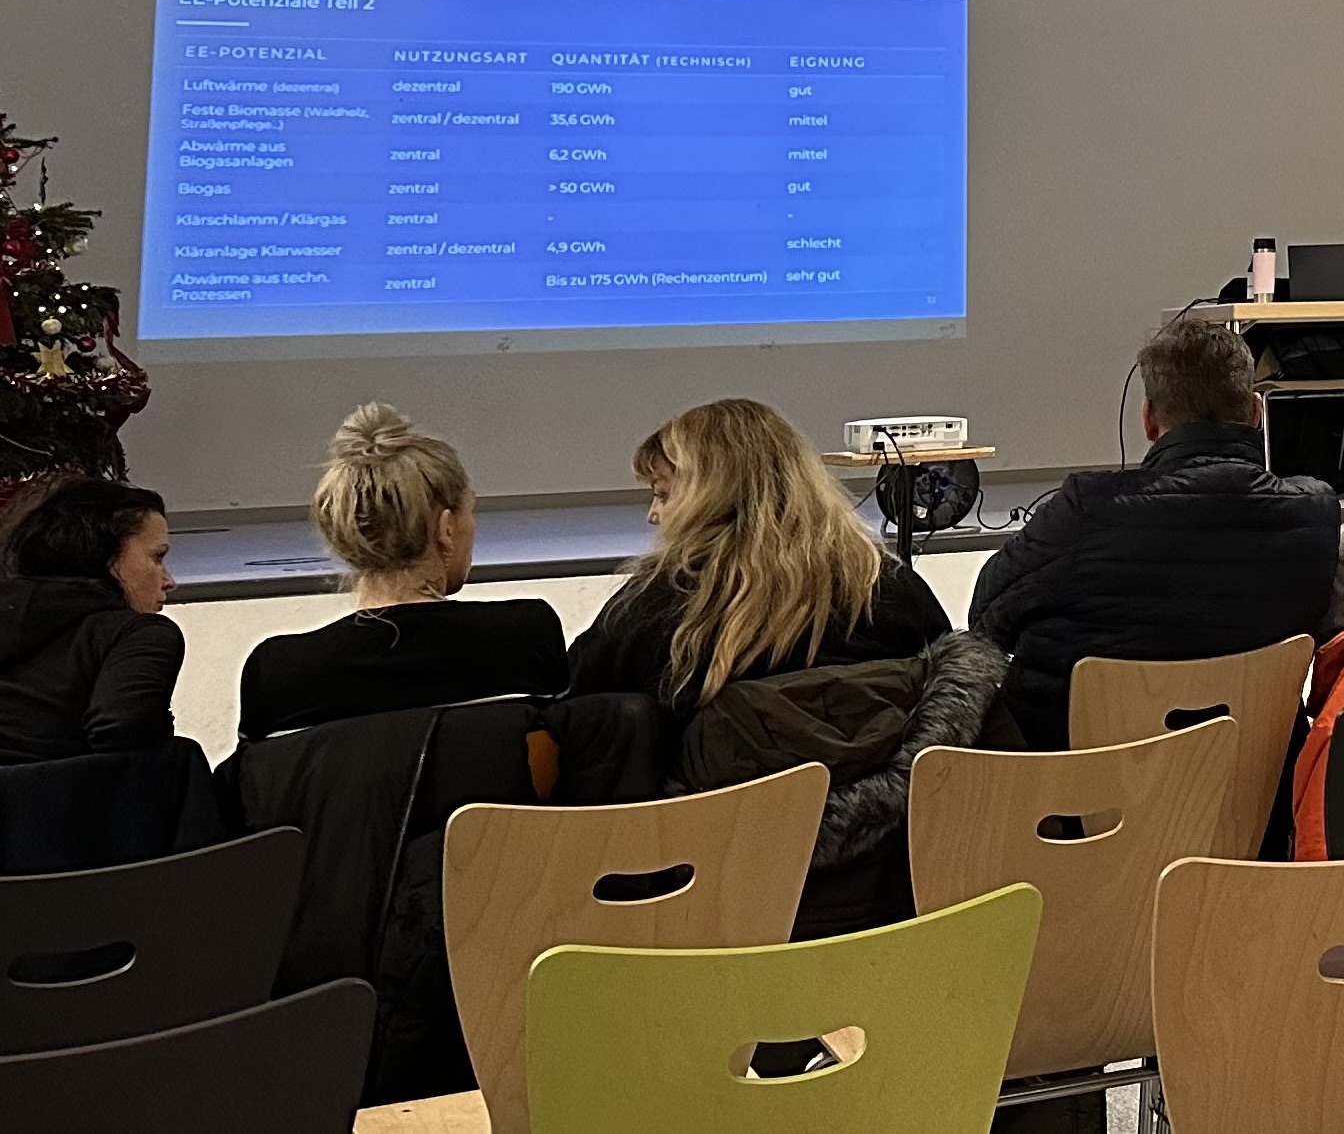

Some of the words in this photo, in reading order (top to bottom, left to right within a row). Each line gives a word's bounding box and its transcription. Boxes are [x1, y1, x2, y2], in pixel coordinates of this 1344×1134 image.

[185, 45, 328, 61] EE-POTENZIAL
[393, 49, 528, 65] NUTZUNGSART
[551, 52, 650, 66] QUANTITÄT
[656, 55, 752, 68] (TECHNISCH)
[789, 56, 866, 69] EIGNUNG
[183, 79, 268, 92] Luftwärme
[272, 83, 340, 95] (dezentral)
[392, 80, 461, 93] dezentral
[551, 82, 575, 94] 190
[576, 82, 612, 95] GWh
[788, 84, 812, 98] gut
[182, 103, 225, 116] Feste
[228, 104, 302, 117] Biomasse
[391, 113, 442, 125] zentral
[443, 112, 451, 126] /
[451, 113, 520, 126] dezentral
[549, 114, 577, 127] 35,6
[579, 114, 615, 126] GWh
[788, 114, 828, 127] mittel
[179, 140, 256, 152] Abwärme
[258, 141, 287, 152] aus
[390, 149, 441, 161] zentral
[548, 149, 569, 162] 6,2
[571, 149, 607, 161] GWh
[788, 148, 828, 161] mittel
[179, 155, 294, 169] Biogasanlagen
[178, 182, 231, 197] Biogas
[388, 183, 439, 195] zentral
[548, 184, 558, 192] >
[559, 182, 578, 194] 50
[579, 182, 615, 194] GWh
[787, 180, 811, 195] gut
[176, 214, 279, 227] Klärschlamm
[280, 213, 289, 227] /
[291, 214, 347, 228] Klärgas
[387, 213, 438, 225] zentral
[386, 243, 437, 256] zentral
[438, 242, 446, 257] /
[447, 242, 516, 256] dezentral
[546, 241, 568, 255] 4,9
[570, 240, 606, 253] GWh
[786, 237, 841, 250] schlecht
[175, 246, 258, 260] Kläranlage
[261, 245, 343, 257] Klarwasser
[171, 273, 250, 286] Abwärme
[252, 273, 280, 285] aus
[283, 271, 331, 284] techn.
[384, 277, 436, 290] zentral
[545, 274, 568, 287] Bis
[569, 276, 587, 287] zu
[590, 273, 611, 286] 175
[613, 273, 649, 286] GWh
[651, 270, 768, 286] (Rechenzentrum)
[786, 269, 815, 282] sehr
[816, 269, 841, 284] gut
[172, 289, 251, 301] Prozessen
